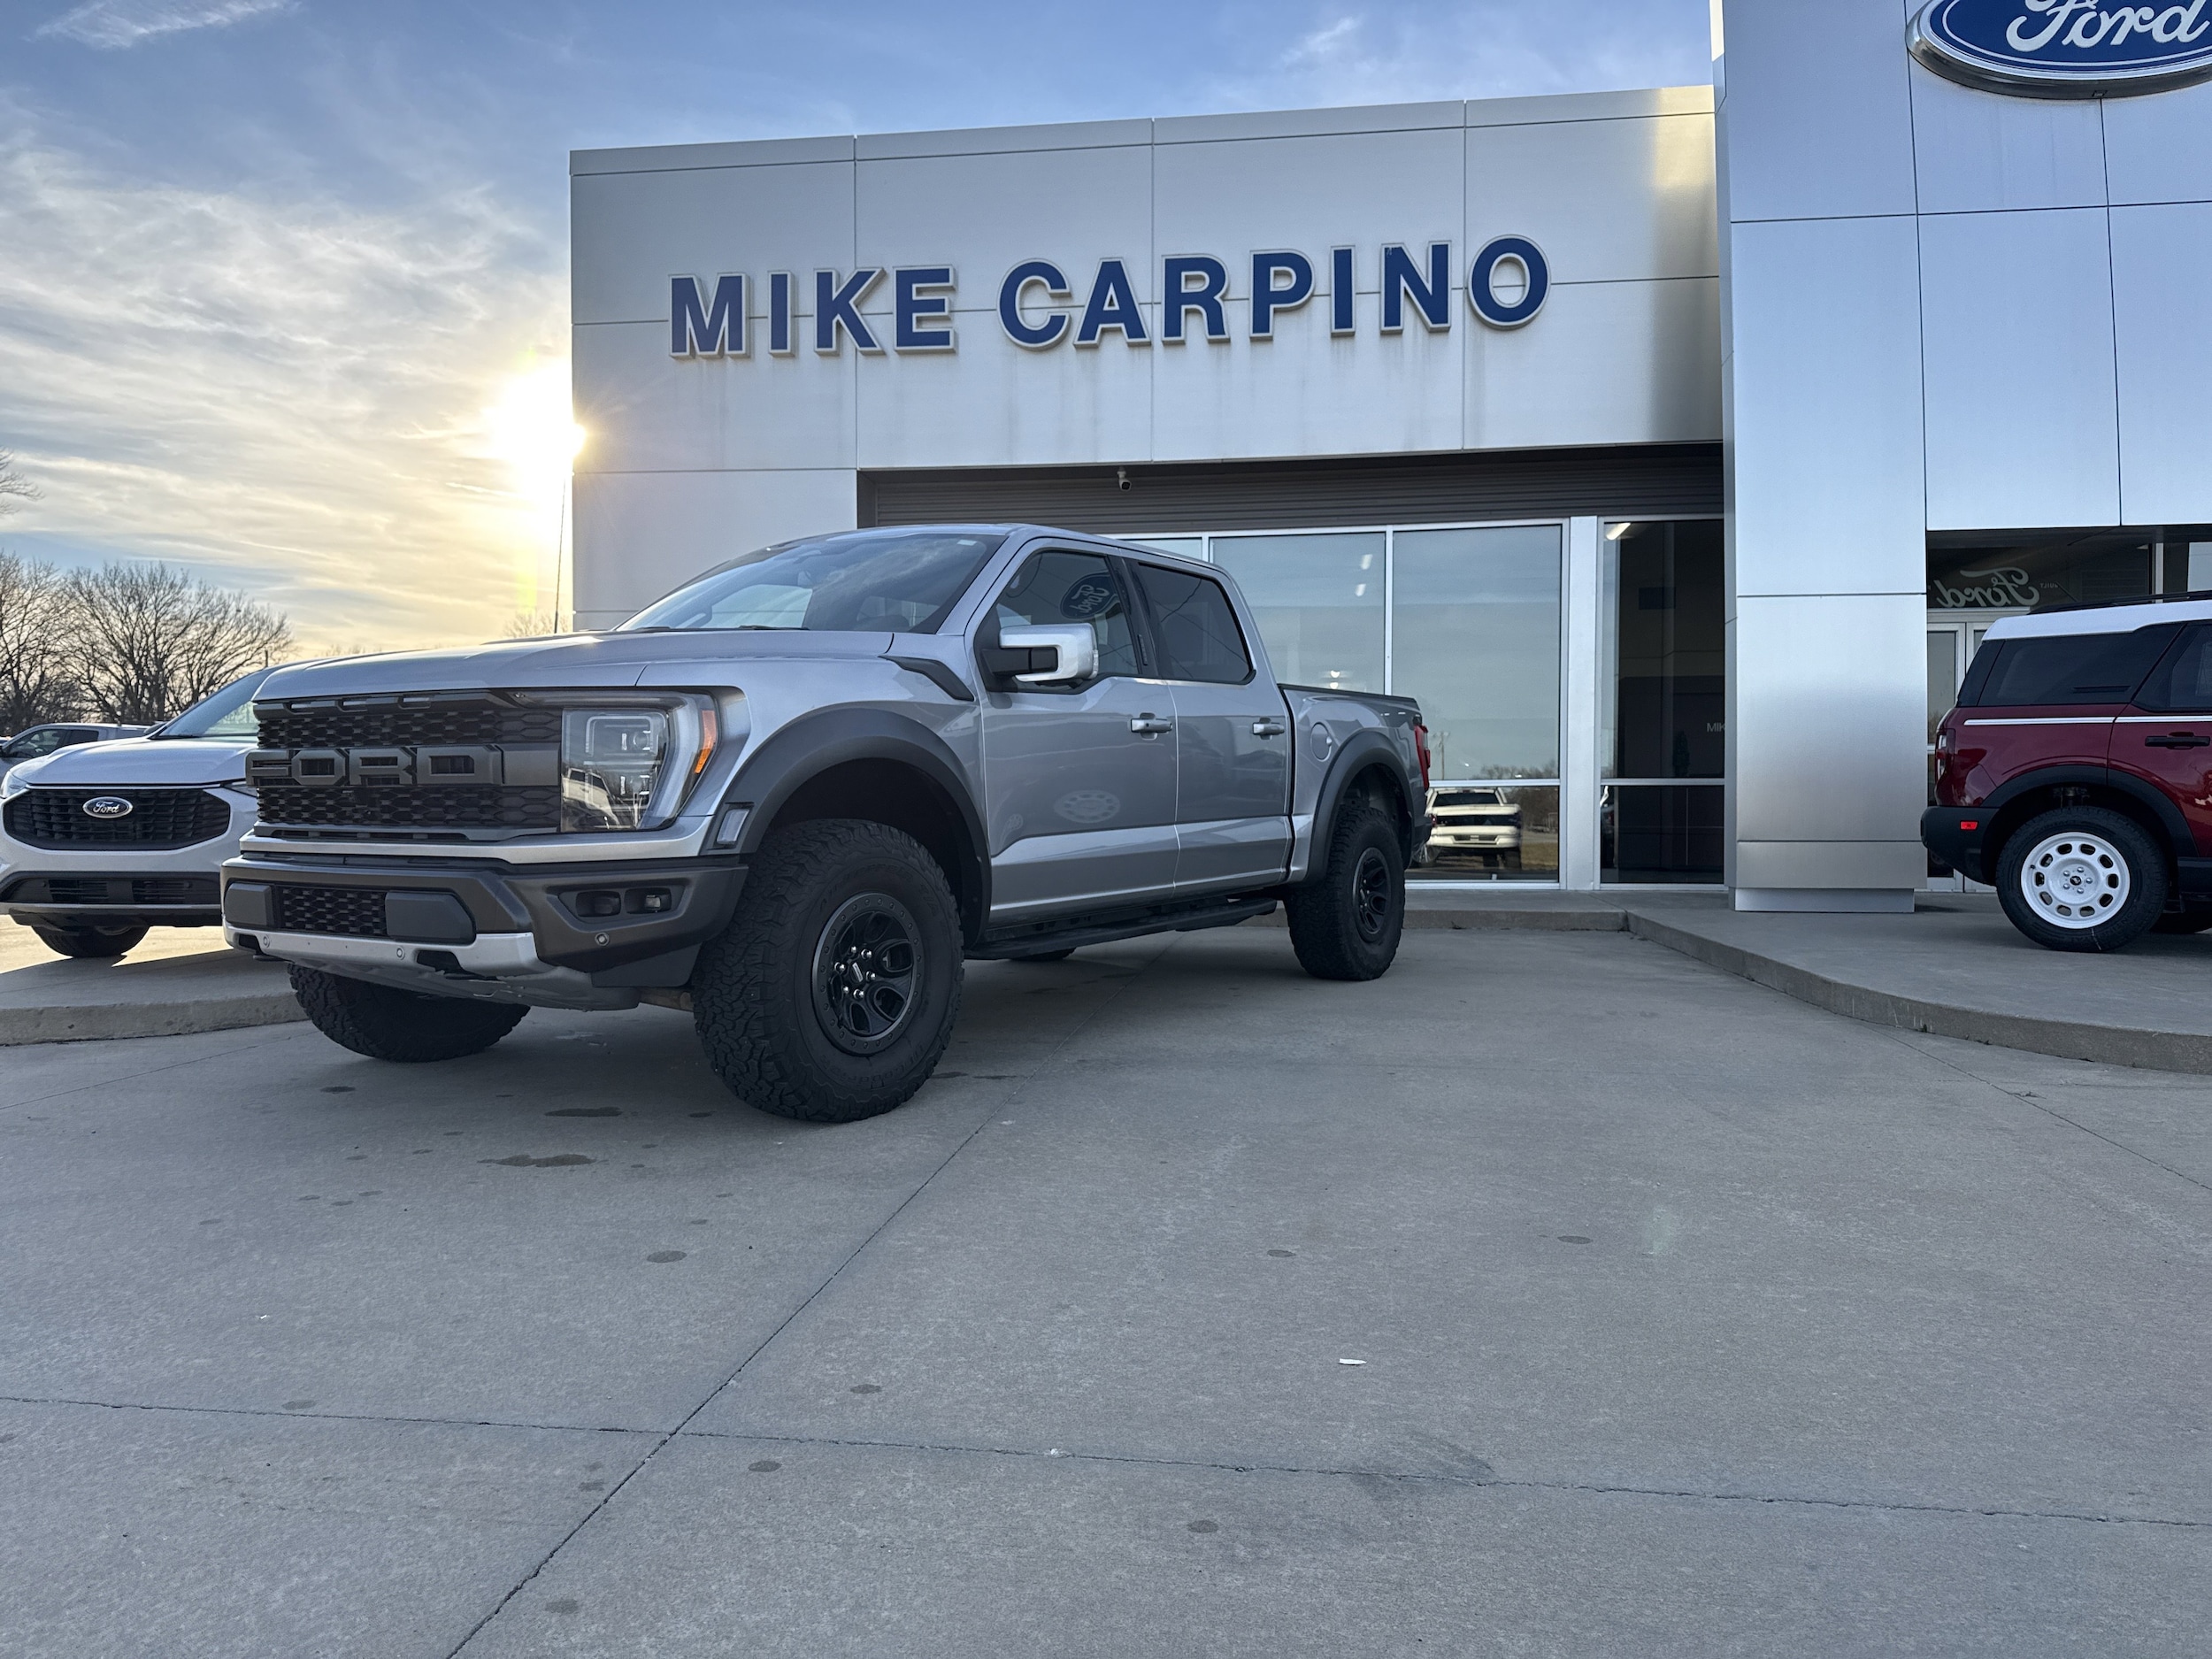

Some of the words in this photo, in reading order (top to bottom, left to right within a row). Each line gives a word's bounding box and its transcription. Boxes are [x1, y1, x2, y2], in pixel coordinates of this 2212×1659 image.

[2006, 0, 2210, 52] Ford
[669, 265, 956, 357] MIKE
[997, 235, 1550, 349] CARPINO
[246, 744, 504, 787] FORD
[93, 801, 120, 813] Ford
